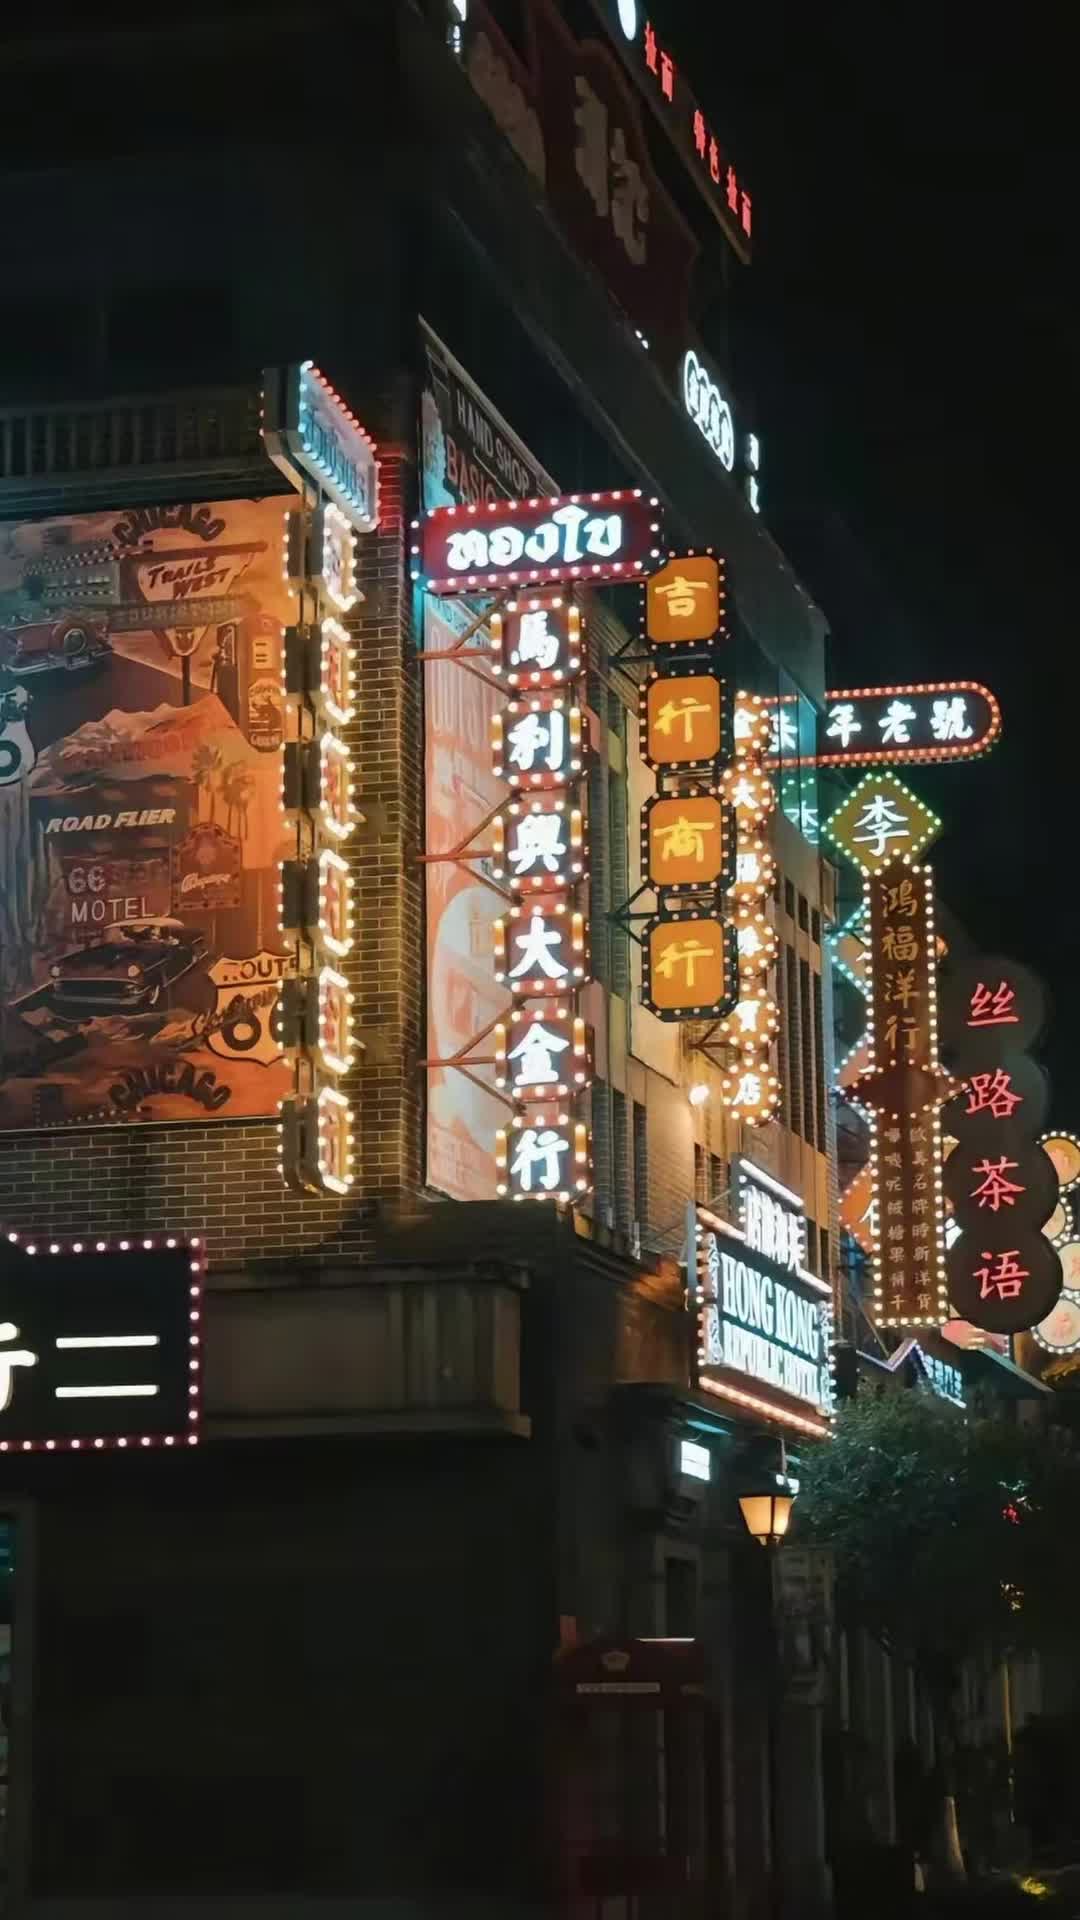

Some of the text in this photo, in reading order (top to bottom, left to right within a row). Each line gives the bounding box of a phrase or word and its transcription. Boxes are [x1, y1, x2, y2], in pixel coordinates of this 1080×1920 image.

[456, 387, 531, 496] HAND SHOP
[46, 814, 112, 833] ROAD
[654, 576, 714, 987] 吉行商行
[852, 794, 910, 857] 李
[71, 896, 155, 924] MOTEL
[880, 878, 921, 1051] 鴻福洋行
[964, 980, 1031, 1301] 丝路茶语
[720, 1252, 819, 1360] HONG KONG
